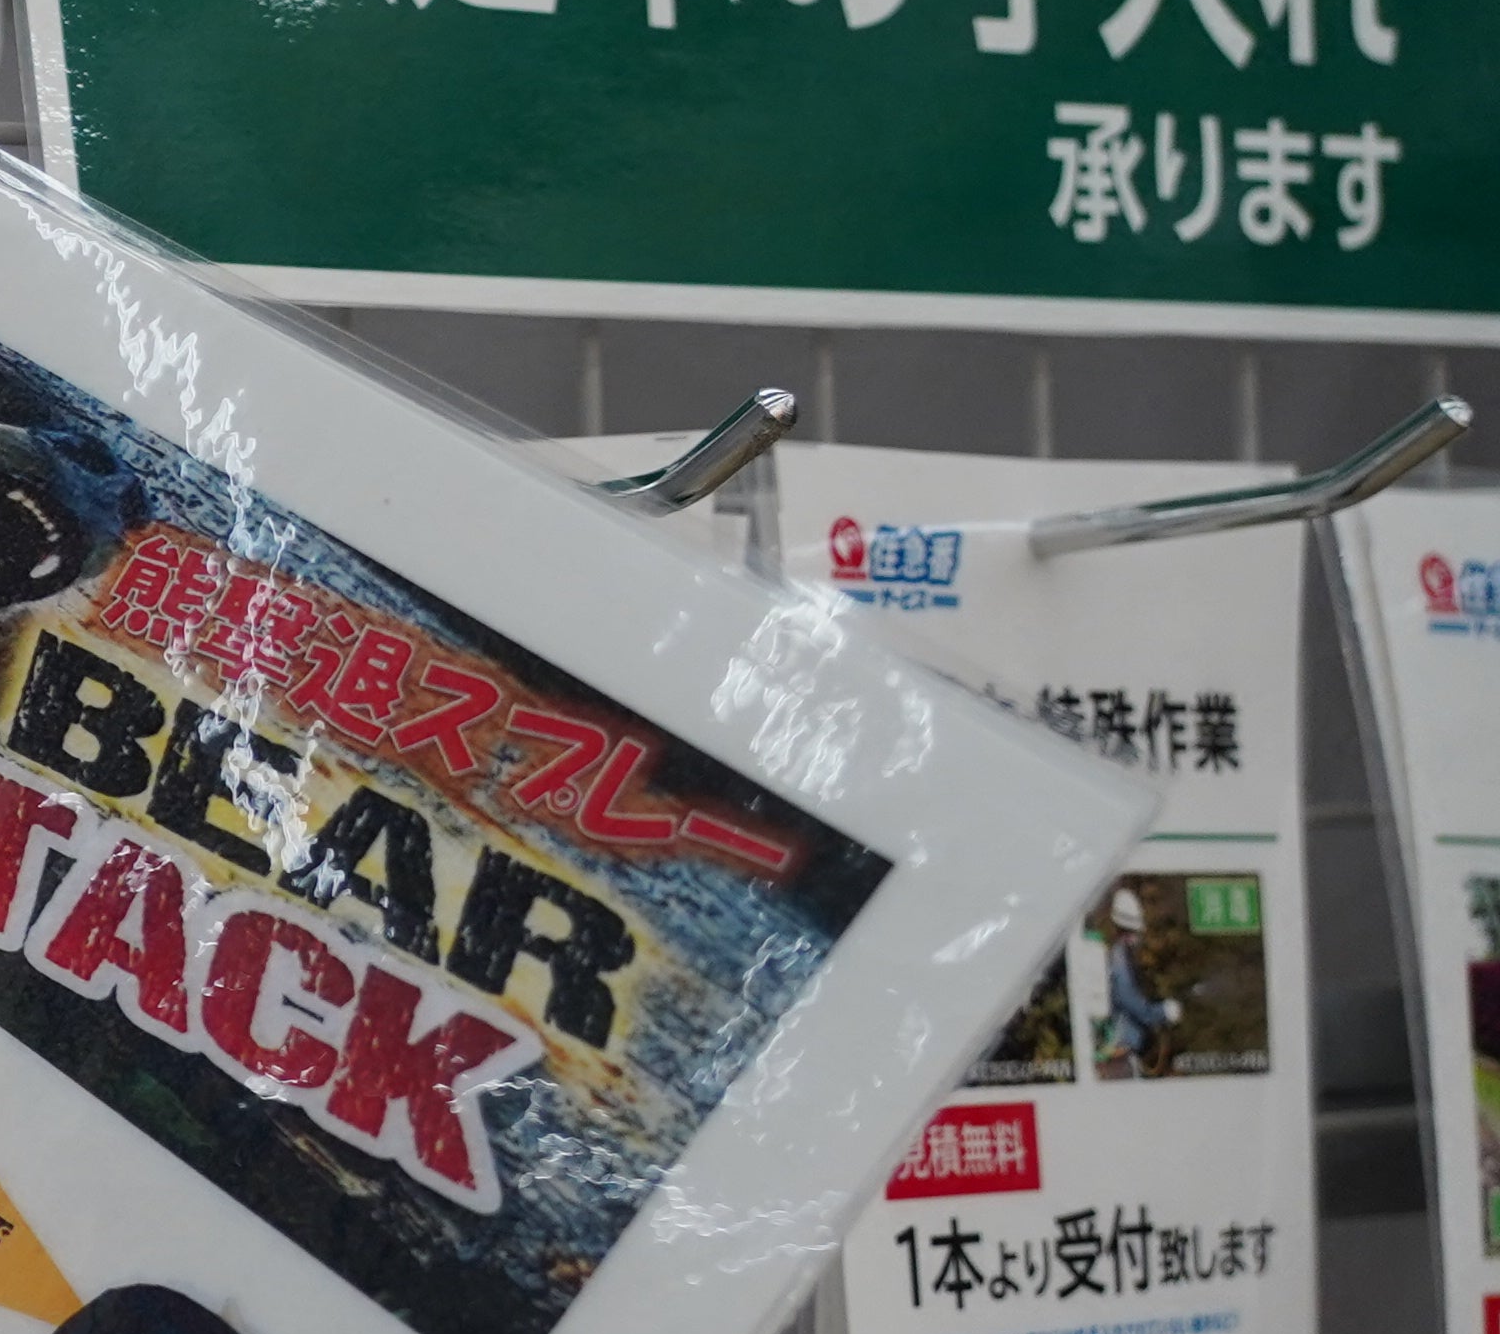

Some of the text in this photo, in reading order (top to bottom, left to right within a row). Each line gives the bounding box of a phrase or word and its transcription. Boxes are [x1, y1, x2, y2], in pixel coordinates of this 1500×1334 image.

[1047, 101, 1401, 251] 承ります
[100, 533, 796, 867] 熊撃退スプレー
[2, 629, 640, 1049] BEAR
[895, 1203, 1277, 1311] 1本より受付致します
